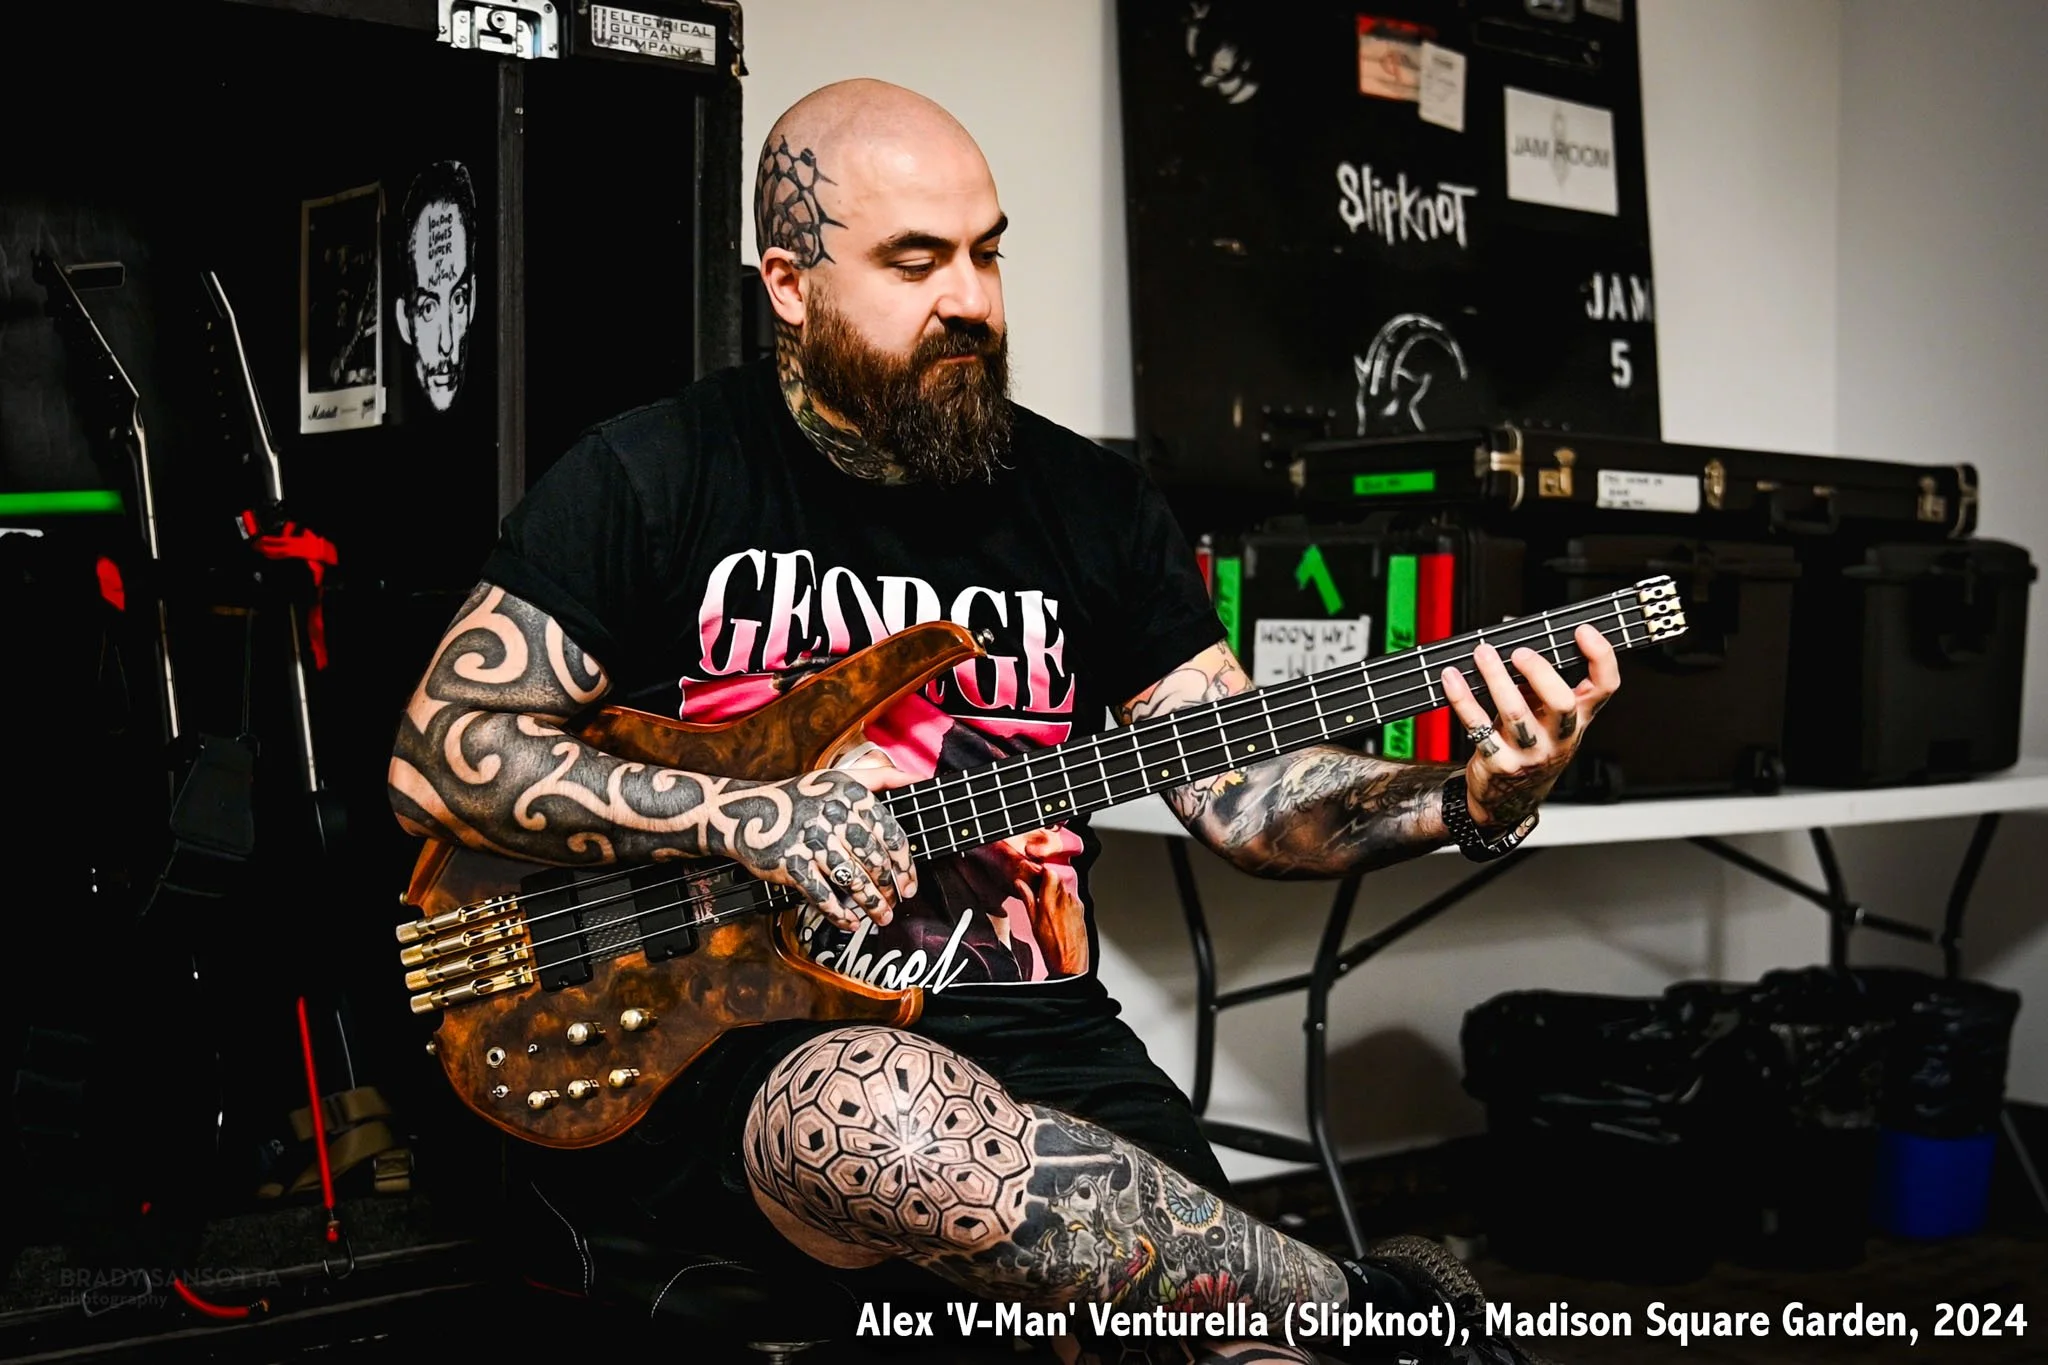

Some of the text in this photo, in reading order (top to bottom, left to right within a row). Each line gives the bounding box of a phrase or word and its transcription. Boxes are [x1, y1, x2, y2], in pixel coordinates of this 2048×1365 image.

[610, 10, 711, 37] ELECTRICAL
[610, 23, 671, 41] GUITAR
[609, 35, 692, 60] COMPANY
[1512, 136, 1610, 169] JAM ROOM
[1611, 339, 1632, 388] 5
